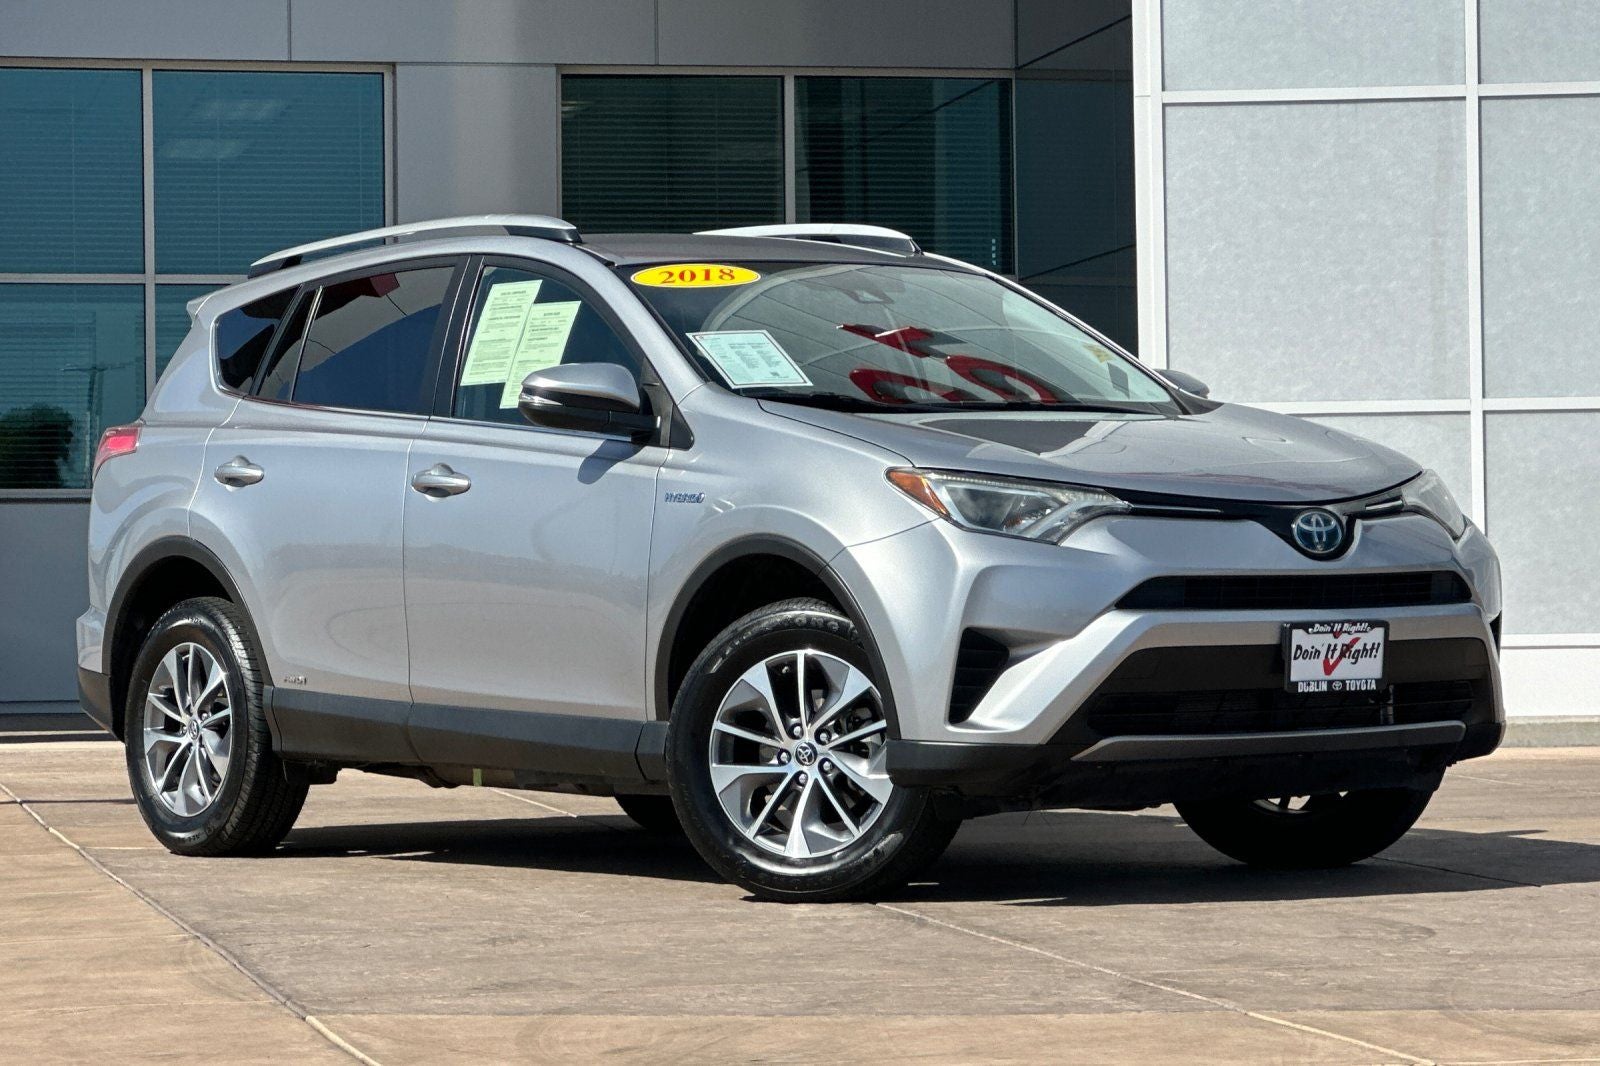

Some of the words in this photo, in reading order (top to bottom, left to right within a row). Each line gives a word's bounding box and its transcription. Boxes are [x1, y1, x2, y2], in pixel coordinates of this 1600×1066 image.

[659, 268, 735, 284] 2018
[1333, 622, 1342, 632] It
[1342, 622, 1369, 634] Right!
[1293, 643, 1324, 661] Doin'
[1325, 643, 1338, 659] It
[1341, 642, 1381, 665] Right!
[1298, 681, 1327, 693] DUBLIN
[1346, 680, 1376, 691] TOYOTA
